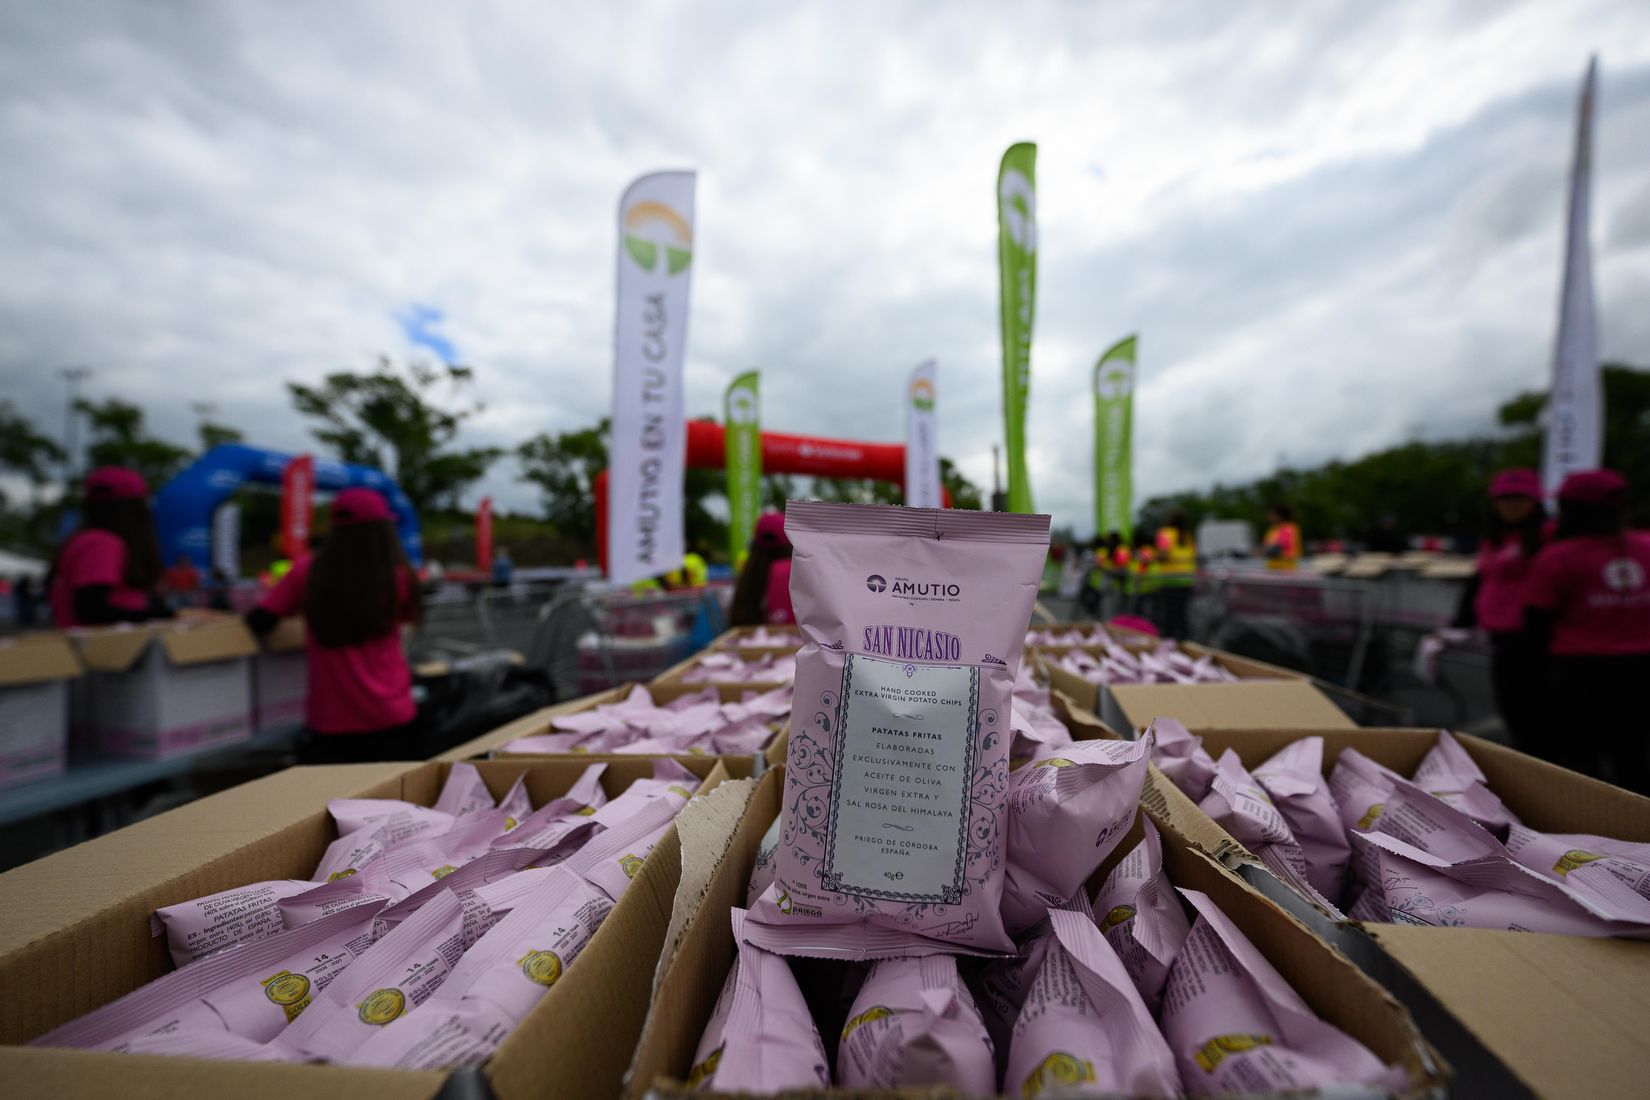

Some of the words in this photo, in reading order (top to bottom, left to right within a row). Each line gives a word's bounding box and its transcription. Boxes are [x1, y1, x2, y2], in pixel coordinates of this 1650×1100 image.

[642, 293, 667, 363] CASA
[642, 368, 665, 403] TU
[641, 413, 664, 453] EN
[637, 458, 661, 565] AMUTIO
[892, 582, 960, 597] AMUTIO
[864, 626, 893, 656] SAN
[896, 627, 962, 661] NICASIO
[854, 689, 879, 699] EXTRA
[880, 692, 906, 702] VIRGIN
[908, 696, 938, 704] POTATO
[941, 699, 962, 707] CHIPS
[881, 686, 901, 695] HAND
[905, 689, 936, 697] COOKED
[872, 727, 909, 738] PATATAS
[912, 731, 942, 740] FRITAS
[876, 742, 935, 755] ELABORADAS
[852, 754, 932, 770] EXCLUSIVAMENTE
[935, 764, 956, 772] CON
[864, 771, 895, 781] ACEITE
[899, 775, 910, 783] DE
[914, 777, 942, 786] OLIVA
[864, 786, 897, 796] VIRGEN
[901, 791, 930, 800] EXTRA
[847, 799, 861, 808] SAL
[865, 801, 888, 811] ROSA
[891, 804, 907, 813] DEL
[910, 807, 953, 818] HIMALAYA
[855, 835, 883, 844] PRIEGO
[900, 839, 938, 850] CÓRDOBA
[881, 847, 910, 856] ESPAÑA
[214, 906, 246, 922] PATATAS
[248, 897, 272, 909] FRITAS
[240, 932, 254, 941] antes
[553, 927, 566, 936] 14
[190, 935, 228, 953] PRODUCTO
[233, 928, 242, 936] DE
[314, 954, 328, 962] 14
